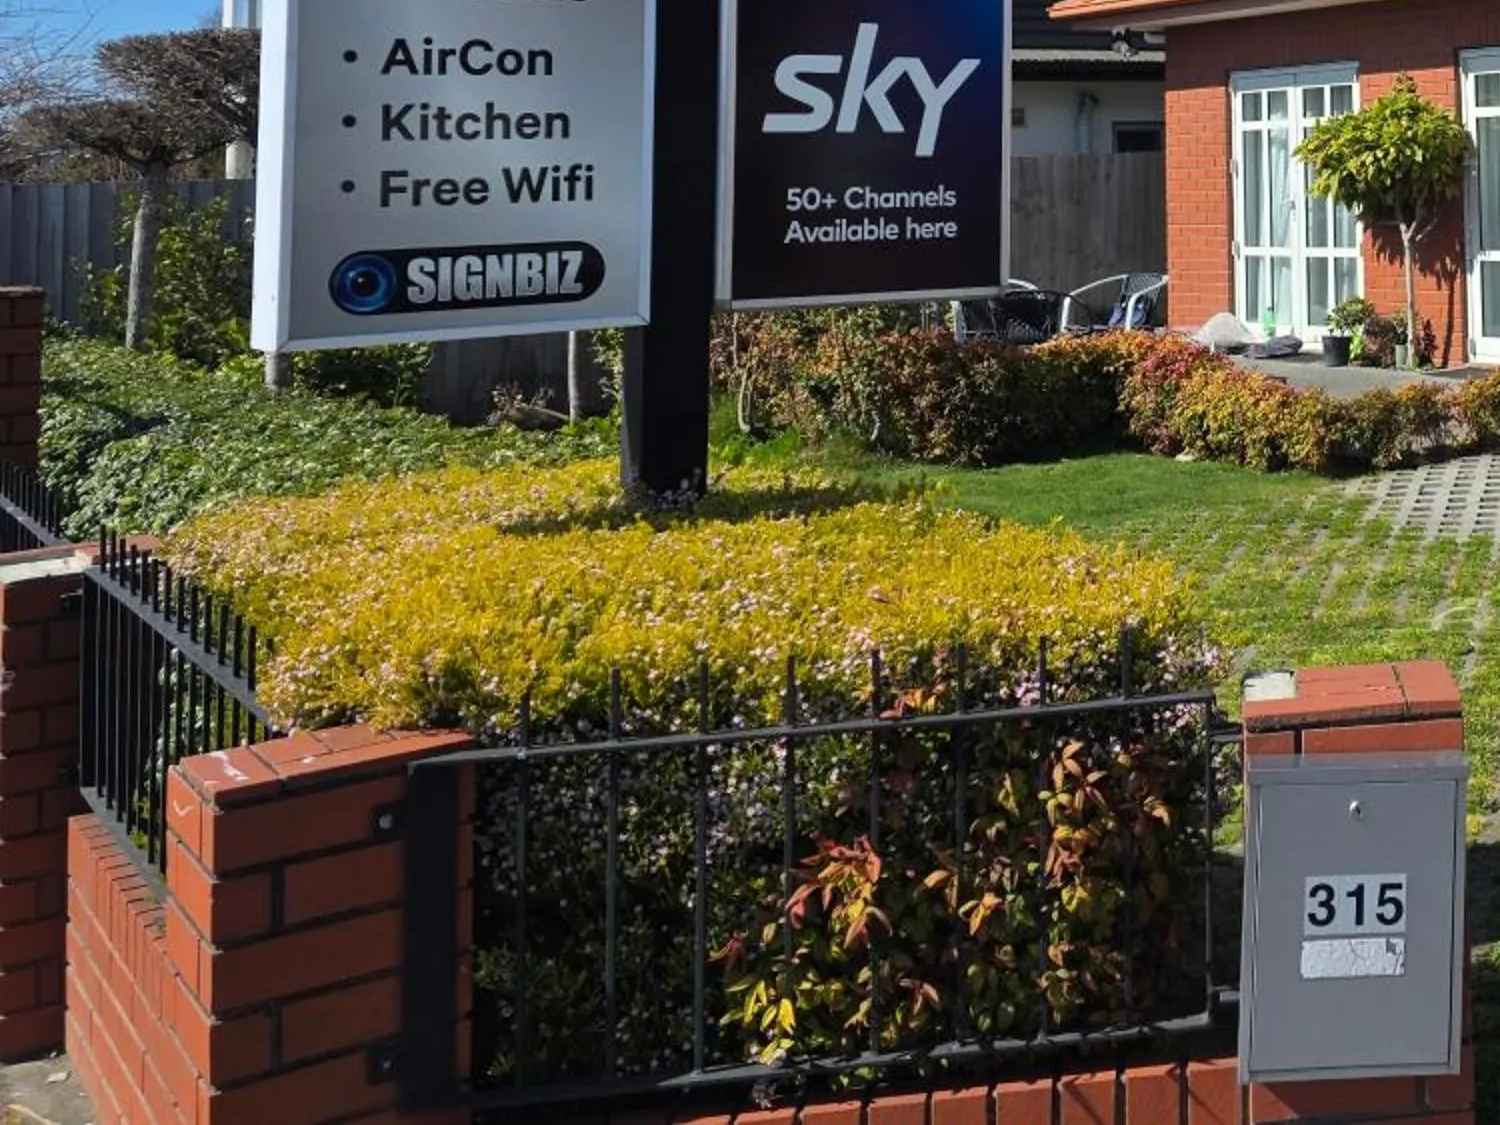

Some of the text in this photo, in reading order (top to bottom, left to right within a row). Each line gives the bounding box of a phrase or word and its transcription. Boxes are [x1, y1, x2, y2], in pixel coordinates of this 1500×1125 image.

[381, 38, 555, 77] AirCon
[761, 22, 981, 158] sky
[380, 103, 570, 141] Kitchen
[379, 164, 595, 208] Free Wifi
[785, 184, 958, 213] 50+ Channels
[783, 215, 958, 245] Available here
[406, 249, 584, 303] SIGNBIZ
[1307, 882, 1404, 927] 315
